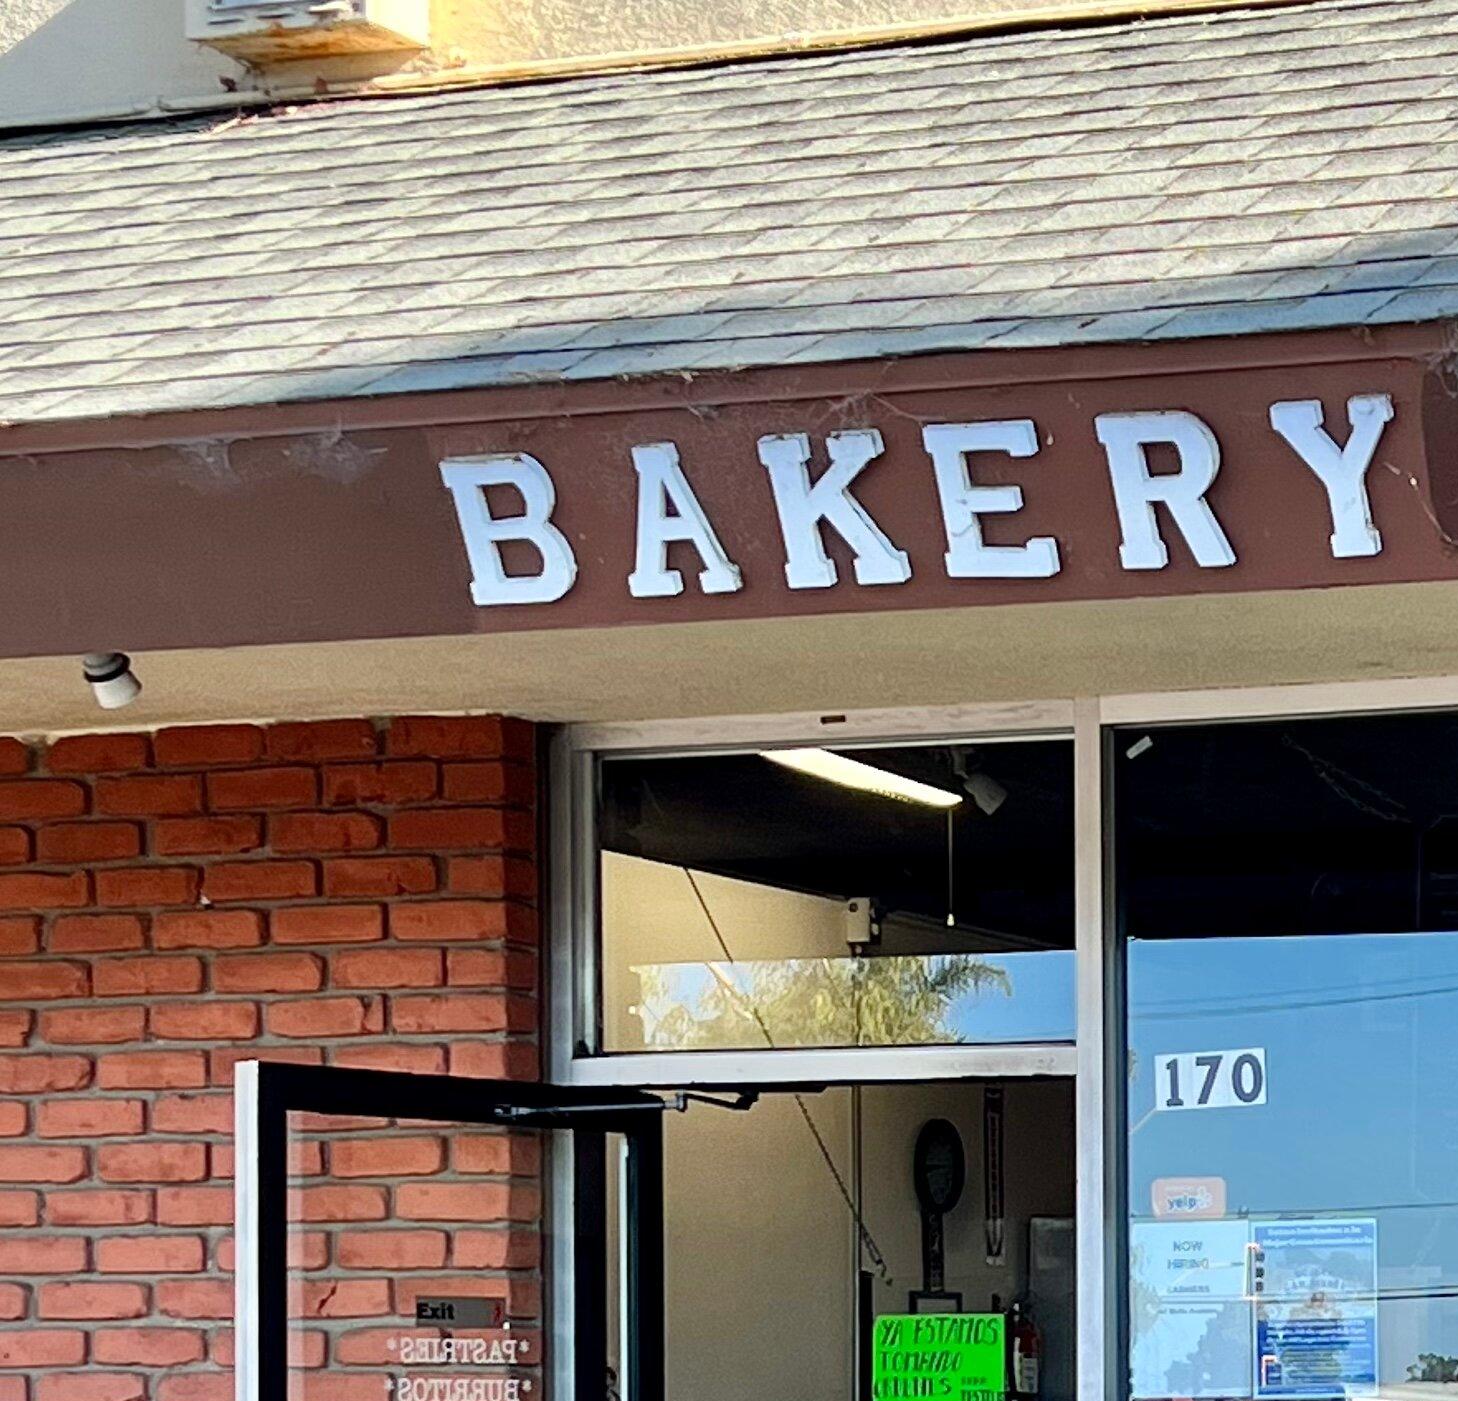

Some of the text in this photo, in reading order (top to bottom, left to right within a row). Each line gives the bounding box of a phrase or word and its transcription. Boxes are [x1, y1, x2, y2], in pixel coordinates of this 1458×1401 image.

[439, 393, 1394, 606] BAKERY
[1165, 1053, 1264, 1107] 170
[416, 1302, 455, 1320] Exit
